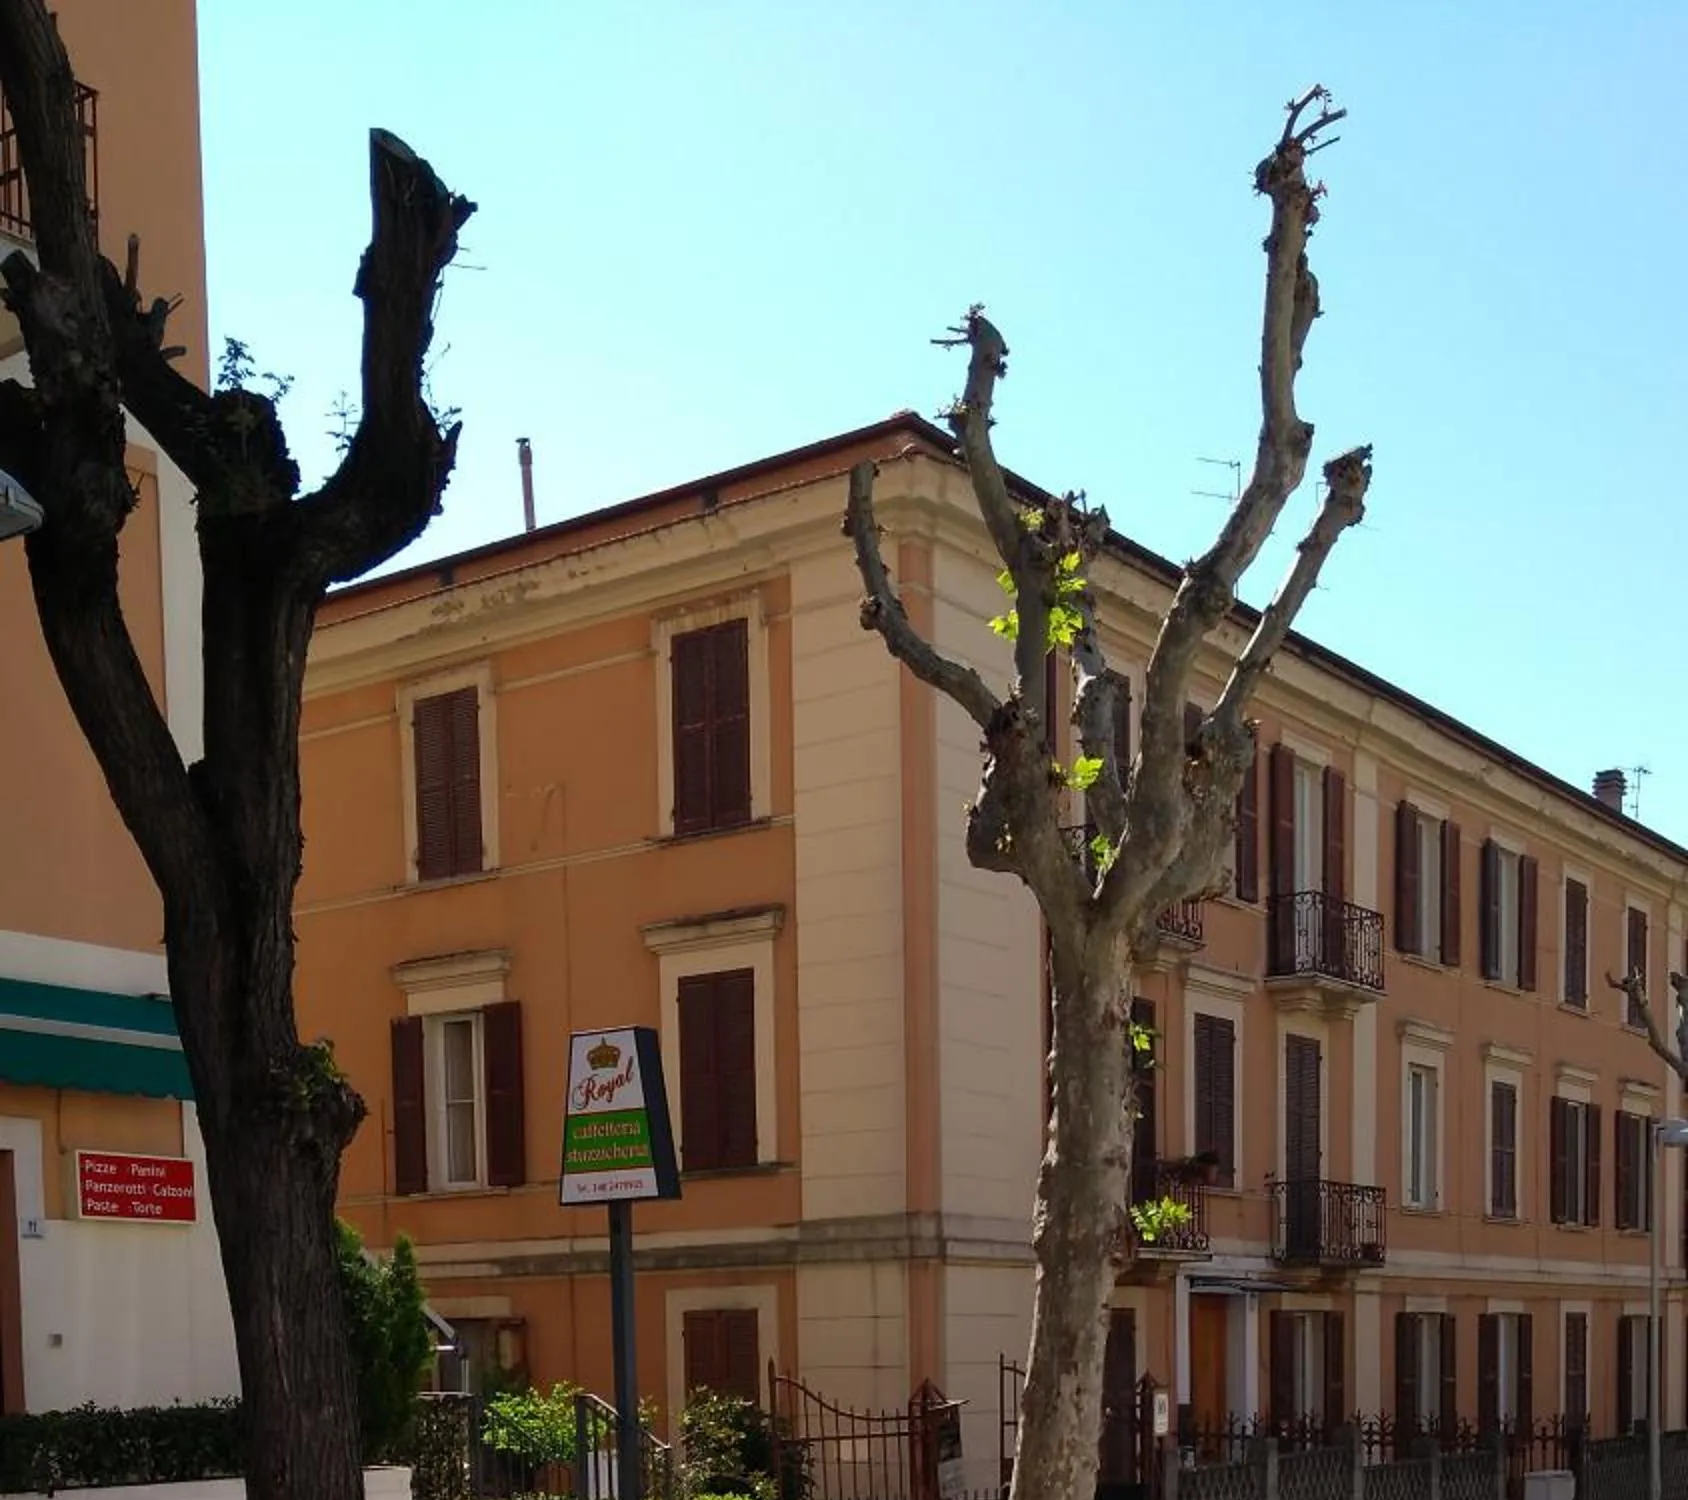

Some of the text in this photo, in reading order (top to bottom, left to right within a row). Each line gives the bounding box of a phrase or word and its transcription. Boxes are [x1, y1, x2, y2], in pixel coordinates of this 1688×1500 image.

[572, 1055, 635, 1111] Royal
[84, 1160, 167, 1178] Pizze Panini
[153, 1183, 194, 1198] Calzoni
[87, 1199, 163, 1215] Paste Torte
